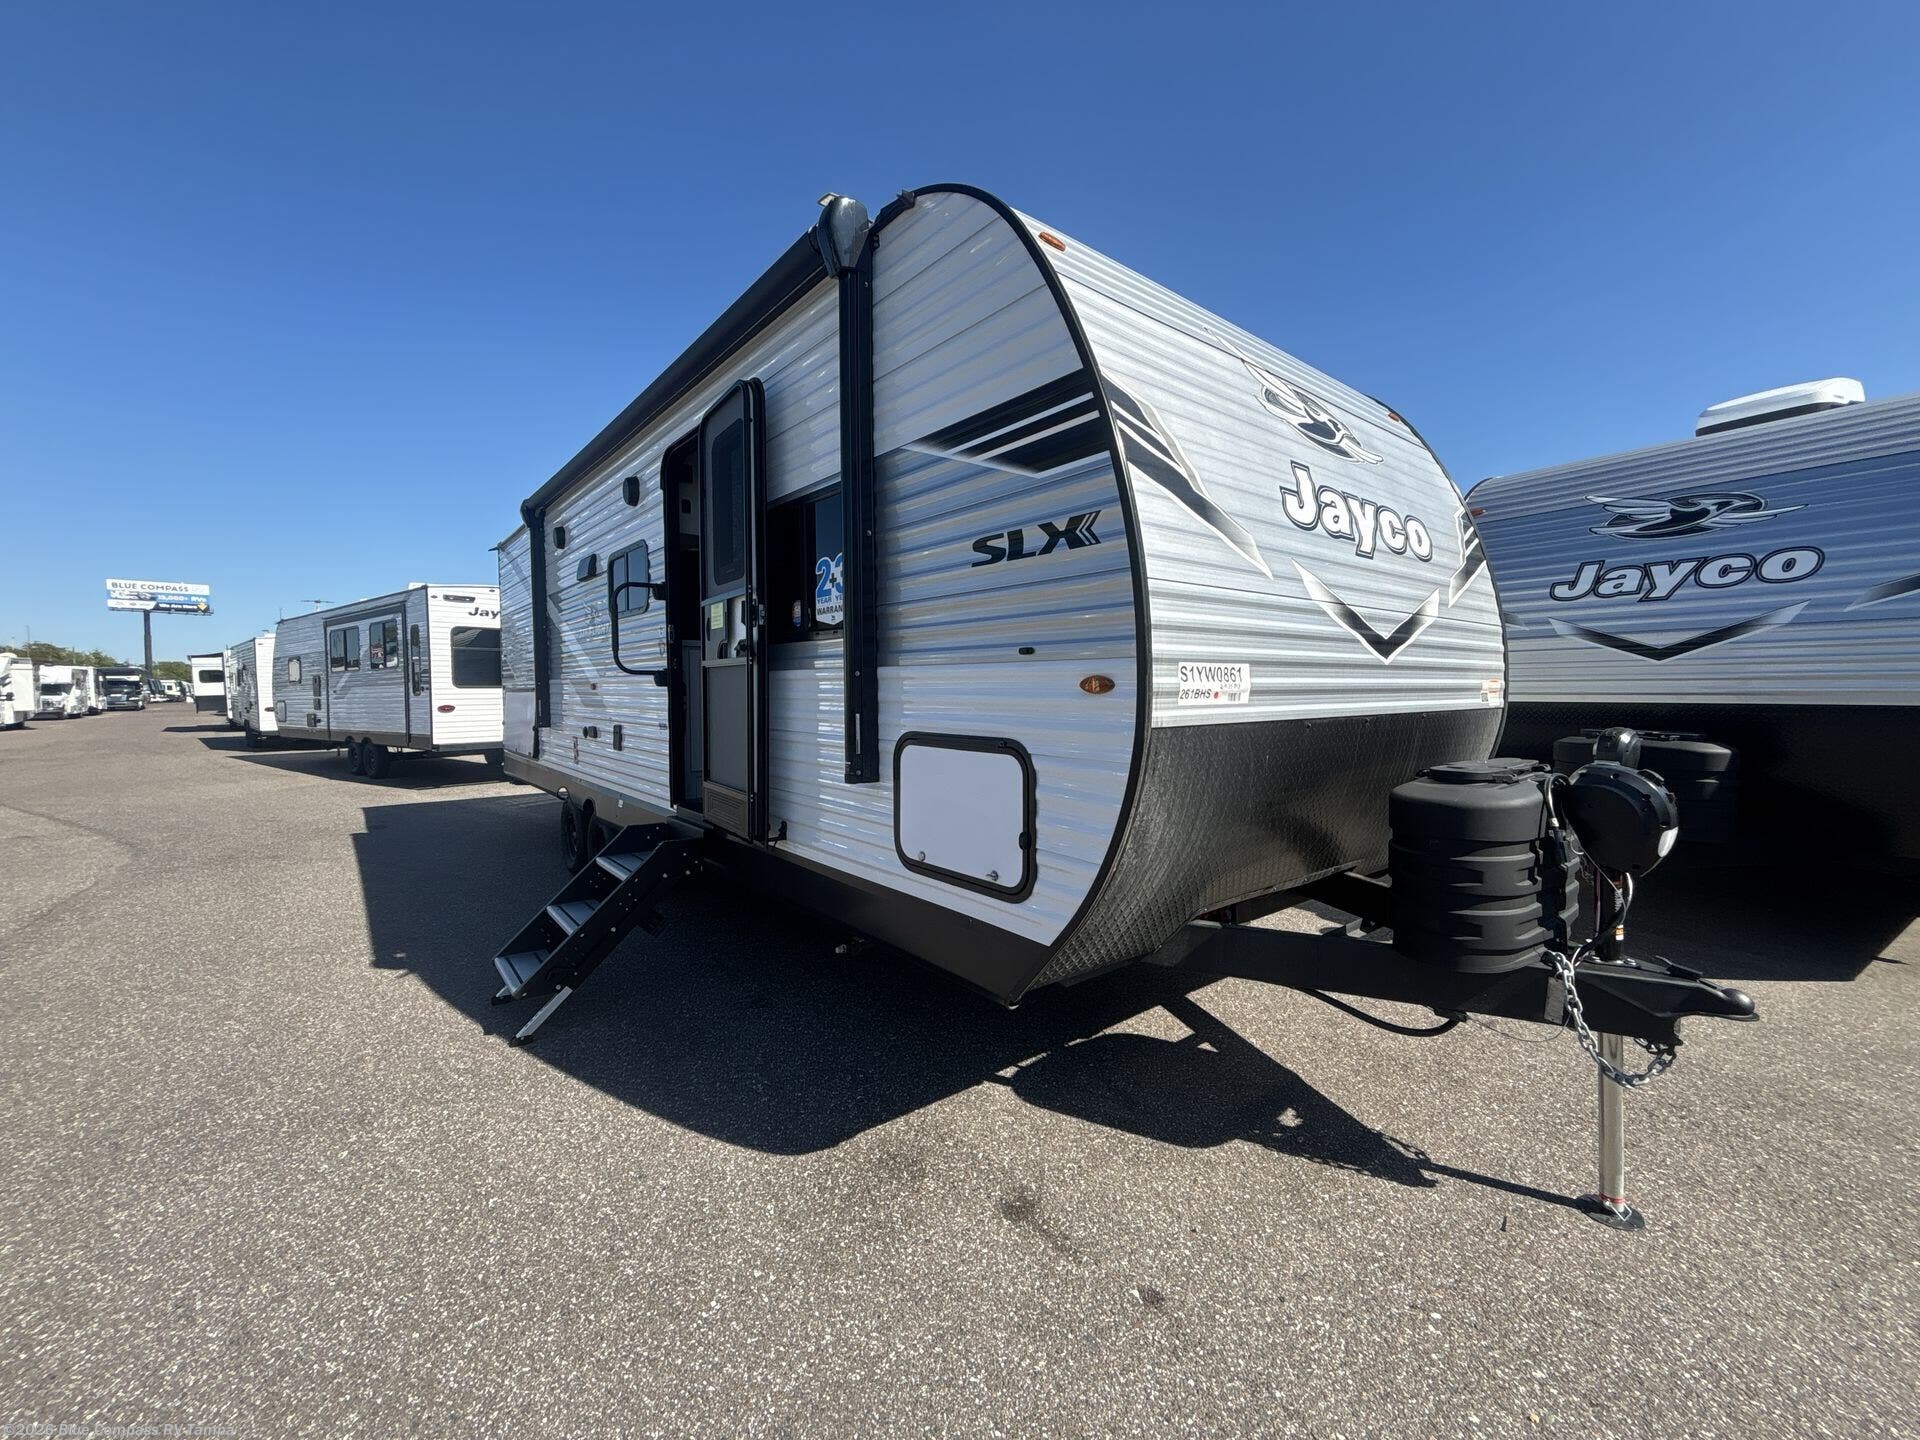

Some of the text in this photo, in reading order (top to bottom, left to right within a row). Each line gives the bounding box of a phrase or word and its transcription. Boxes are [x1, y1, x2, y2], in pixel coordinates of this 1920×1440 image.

[1279, 460, 1433, 563] Jayco
[971, 510, 1101, 568] SLX
[1550, 546, 1825, 602] Jayco
[111, 582, 137, 590] BLUE
[140, 583, 189, 593] COMPASS
[468, 607, 500, 620] Jay
[817, 605, 843, 616] WARRAN
[1180, 665, 1242, 683] S1YW0861
[1180, 688, 1212, 700] 261BHS
